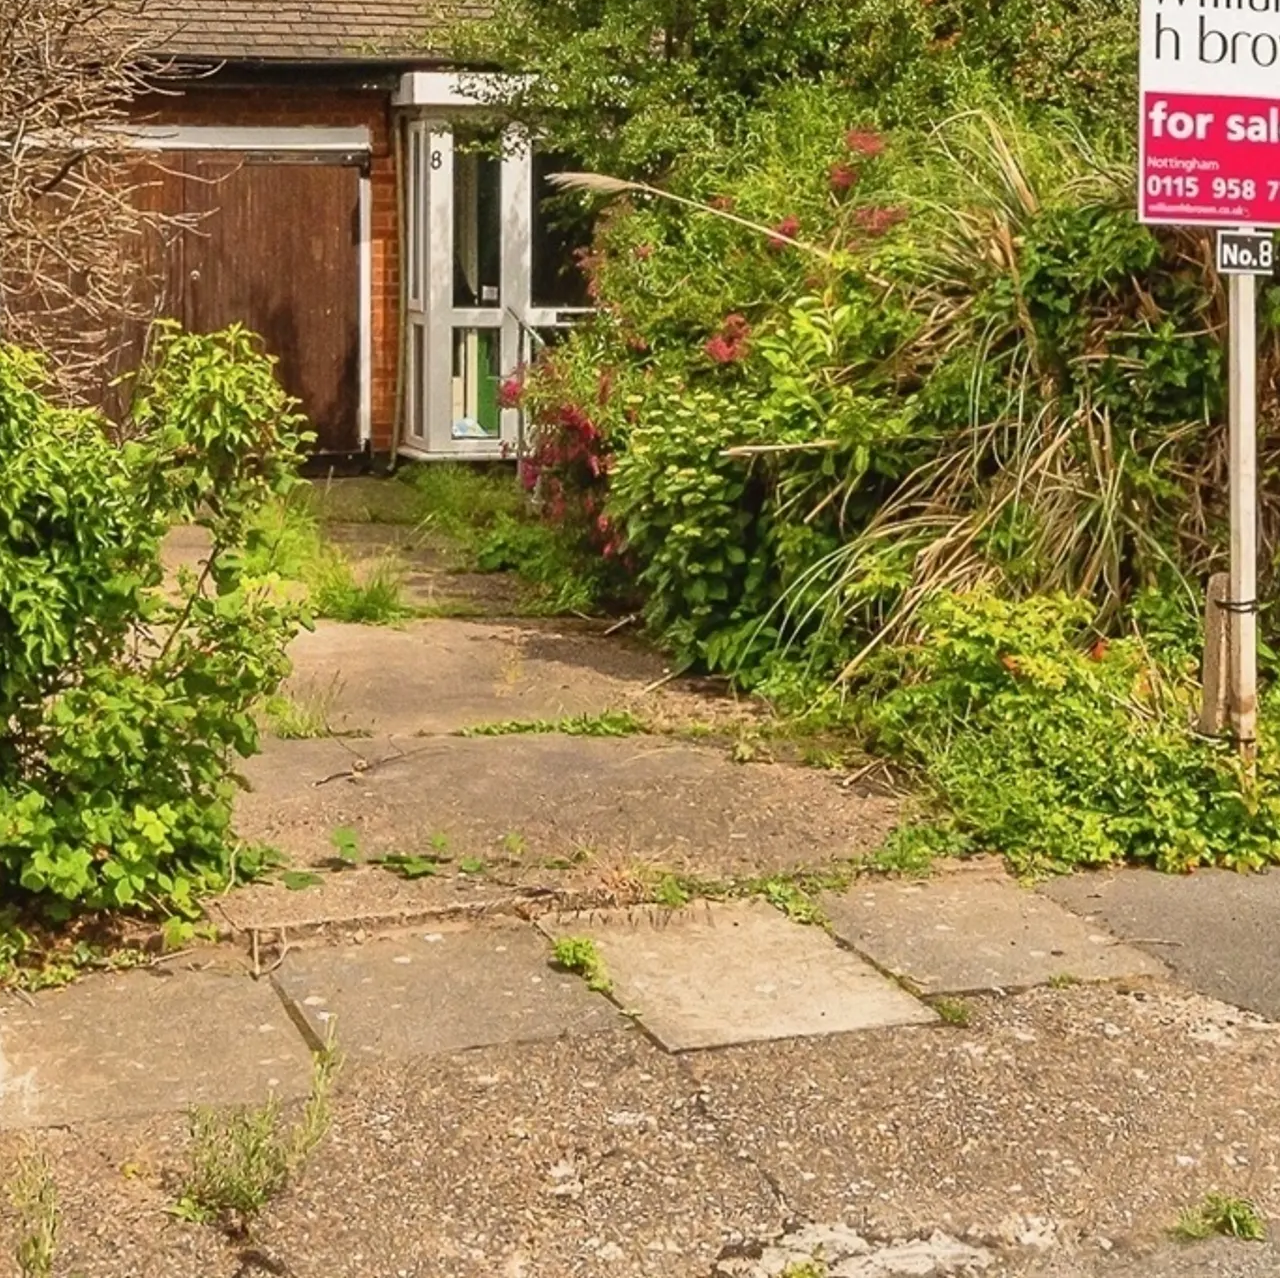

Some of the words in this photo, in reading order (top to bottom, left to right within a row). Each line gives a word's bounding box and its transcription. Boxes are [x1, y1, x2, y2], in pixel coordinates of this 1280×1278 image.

[1156, 13, 1180, 60] h
[1148, 101, 1214, 140] for
[430, 150, 442, 170] 8
[1147, 156, 1220, 172] Nottingham
[1147, 175, 1200, 198] 0115
[1212, 178, 1256, 201] 958
[1222, 240, 1273, 267] No.8
